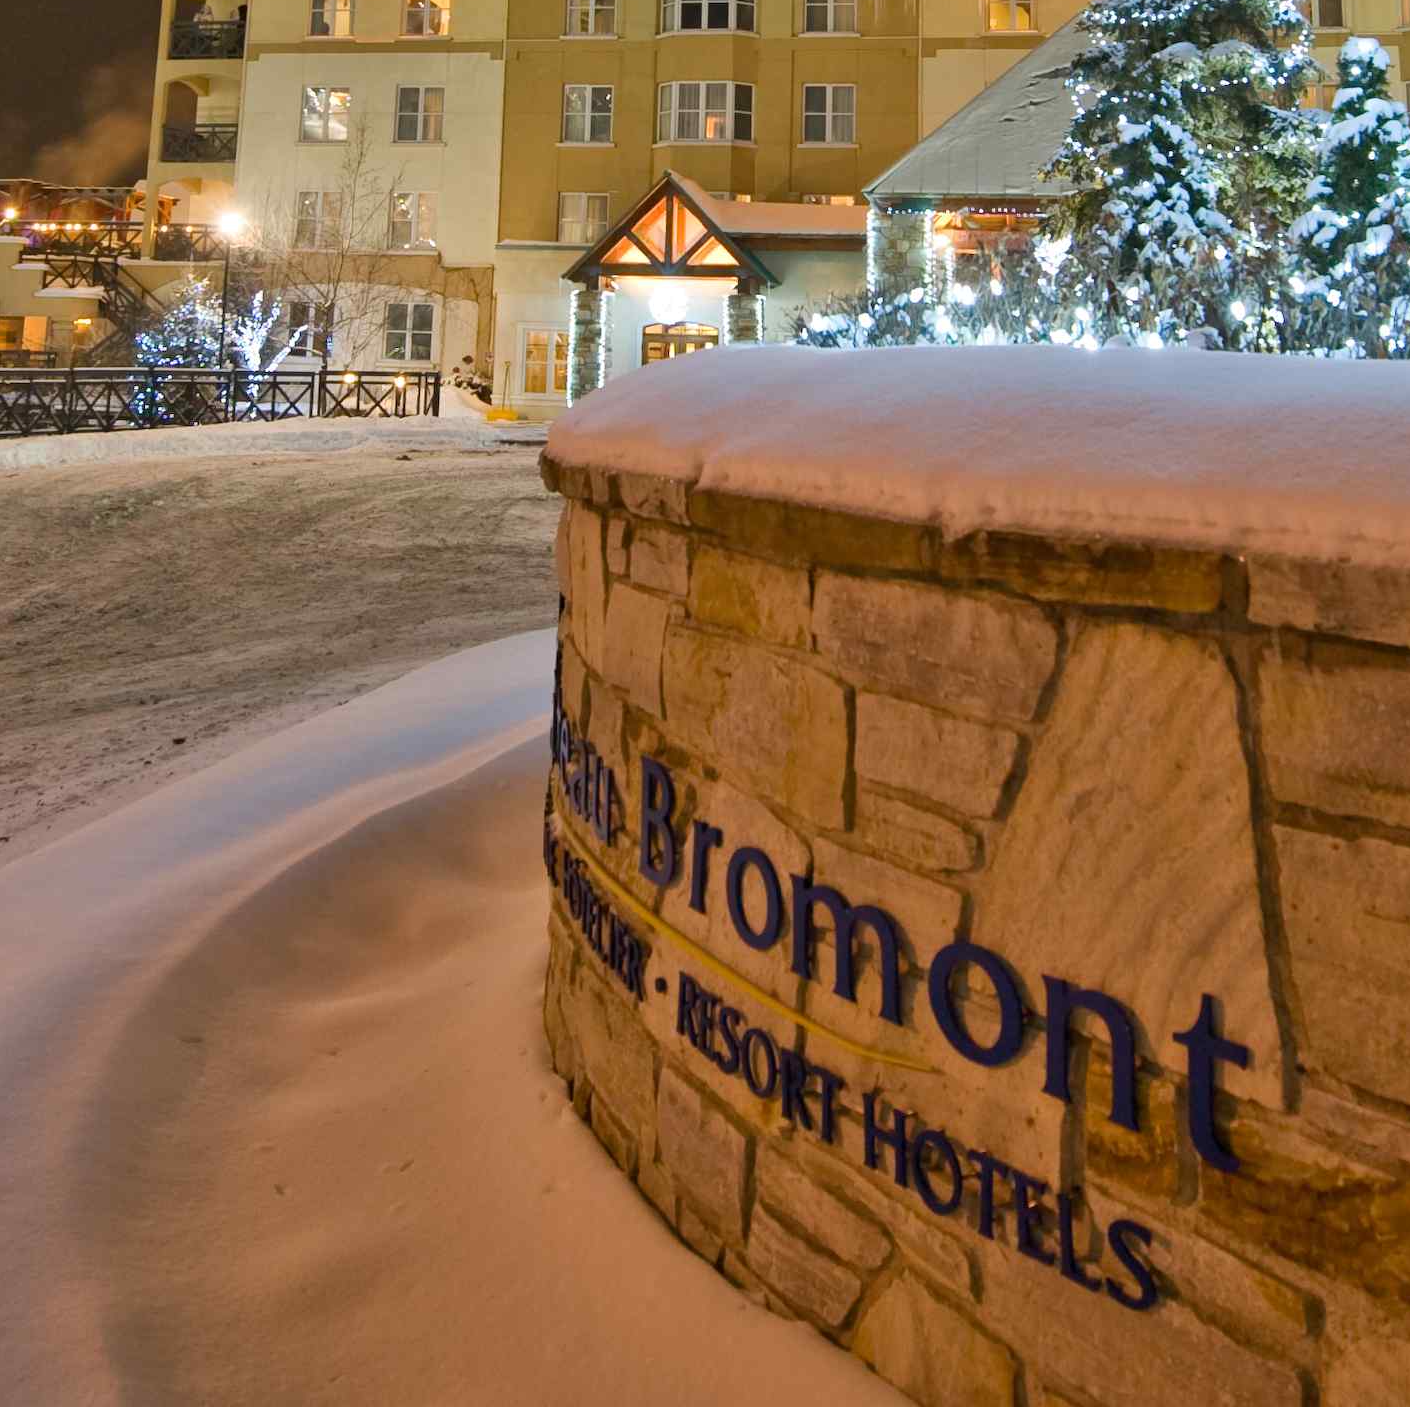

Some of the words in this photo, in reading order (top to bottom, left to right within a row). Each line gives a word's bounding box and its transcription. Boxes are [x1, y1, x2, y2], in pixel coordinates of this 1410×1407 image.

[640, 756, 1251, 1173] Bromont
[677, 971, 843, 1144] RESORT
[862, 1090, 1162, 1312] HOTELS
